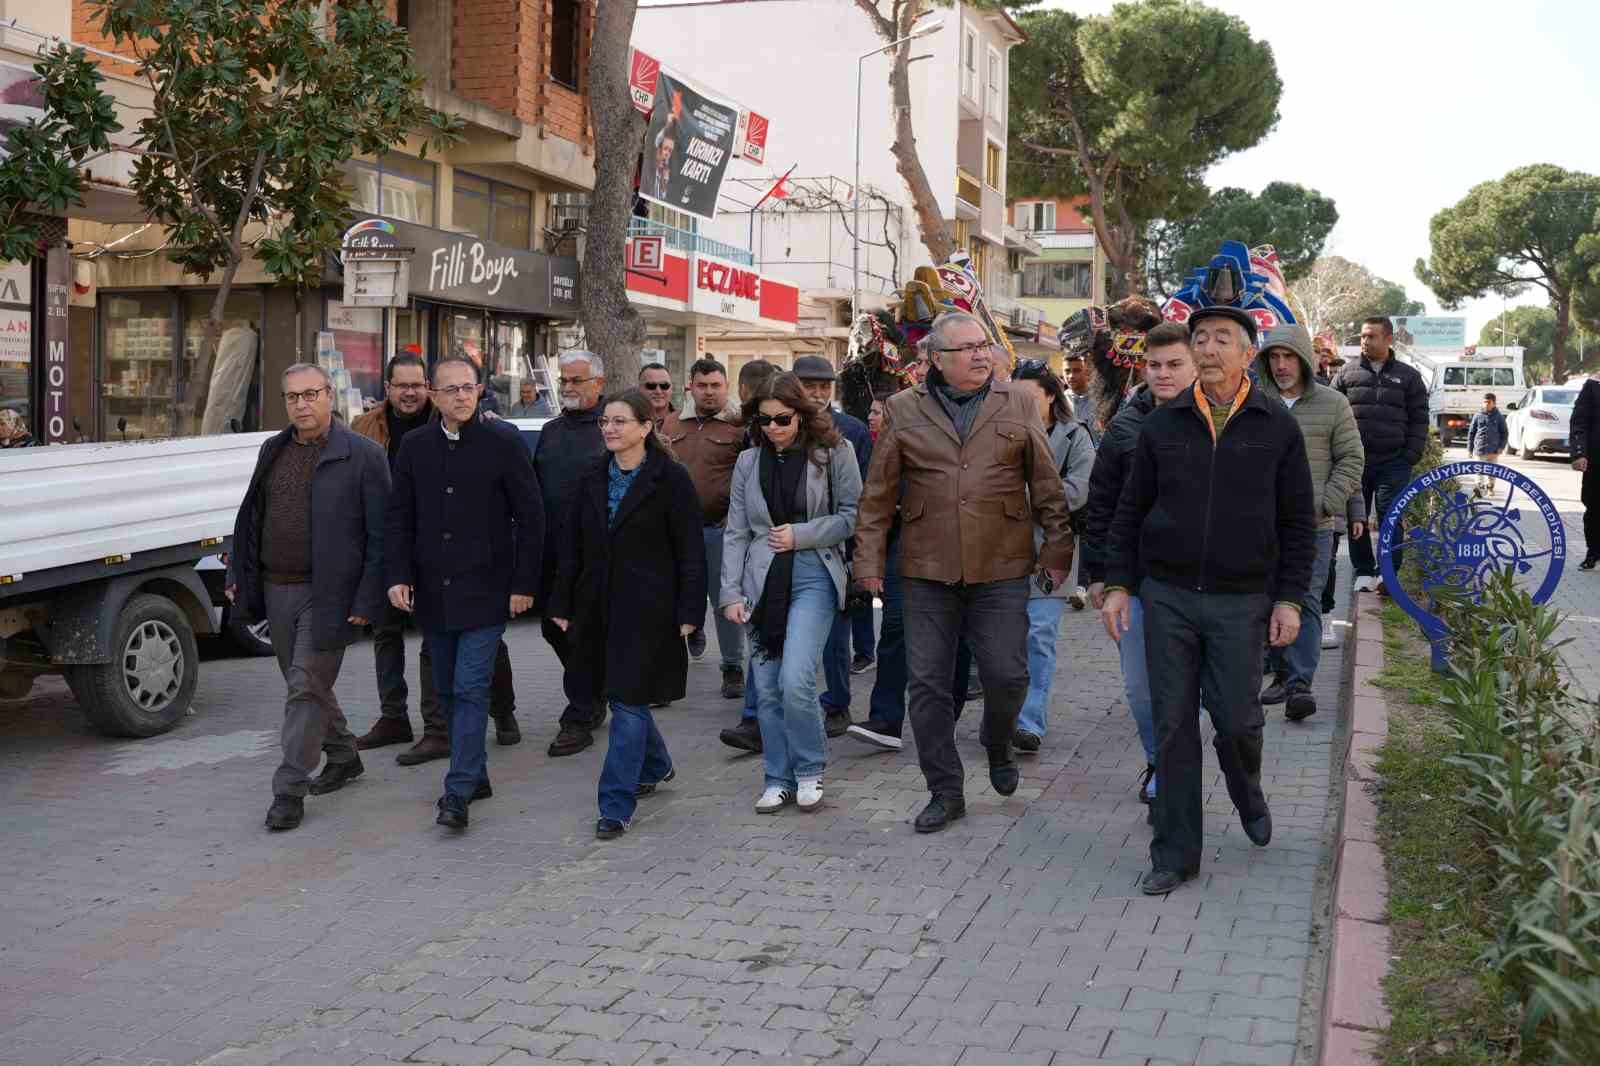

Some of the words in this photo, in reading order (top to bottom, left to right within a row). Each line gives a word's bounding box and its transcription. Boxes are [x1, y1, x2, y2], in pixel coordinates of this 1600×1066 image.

[634, 89, 649, 104] CHP
[680, 159, 712, 184] KART!
[640, 242, 653, 263] E
[428, 241, 467, 292] Filli
[470, 242, 519, 296] Boya
[697, 258, 760, 301] ECZANE
[1388, 487, 1419, 526] AYDIN
[1521, 481, 1565, 560] BELEDİYESİ
[1458, 543, 1486, 558] 1881
